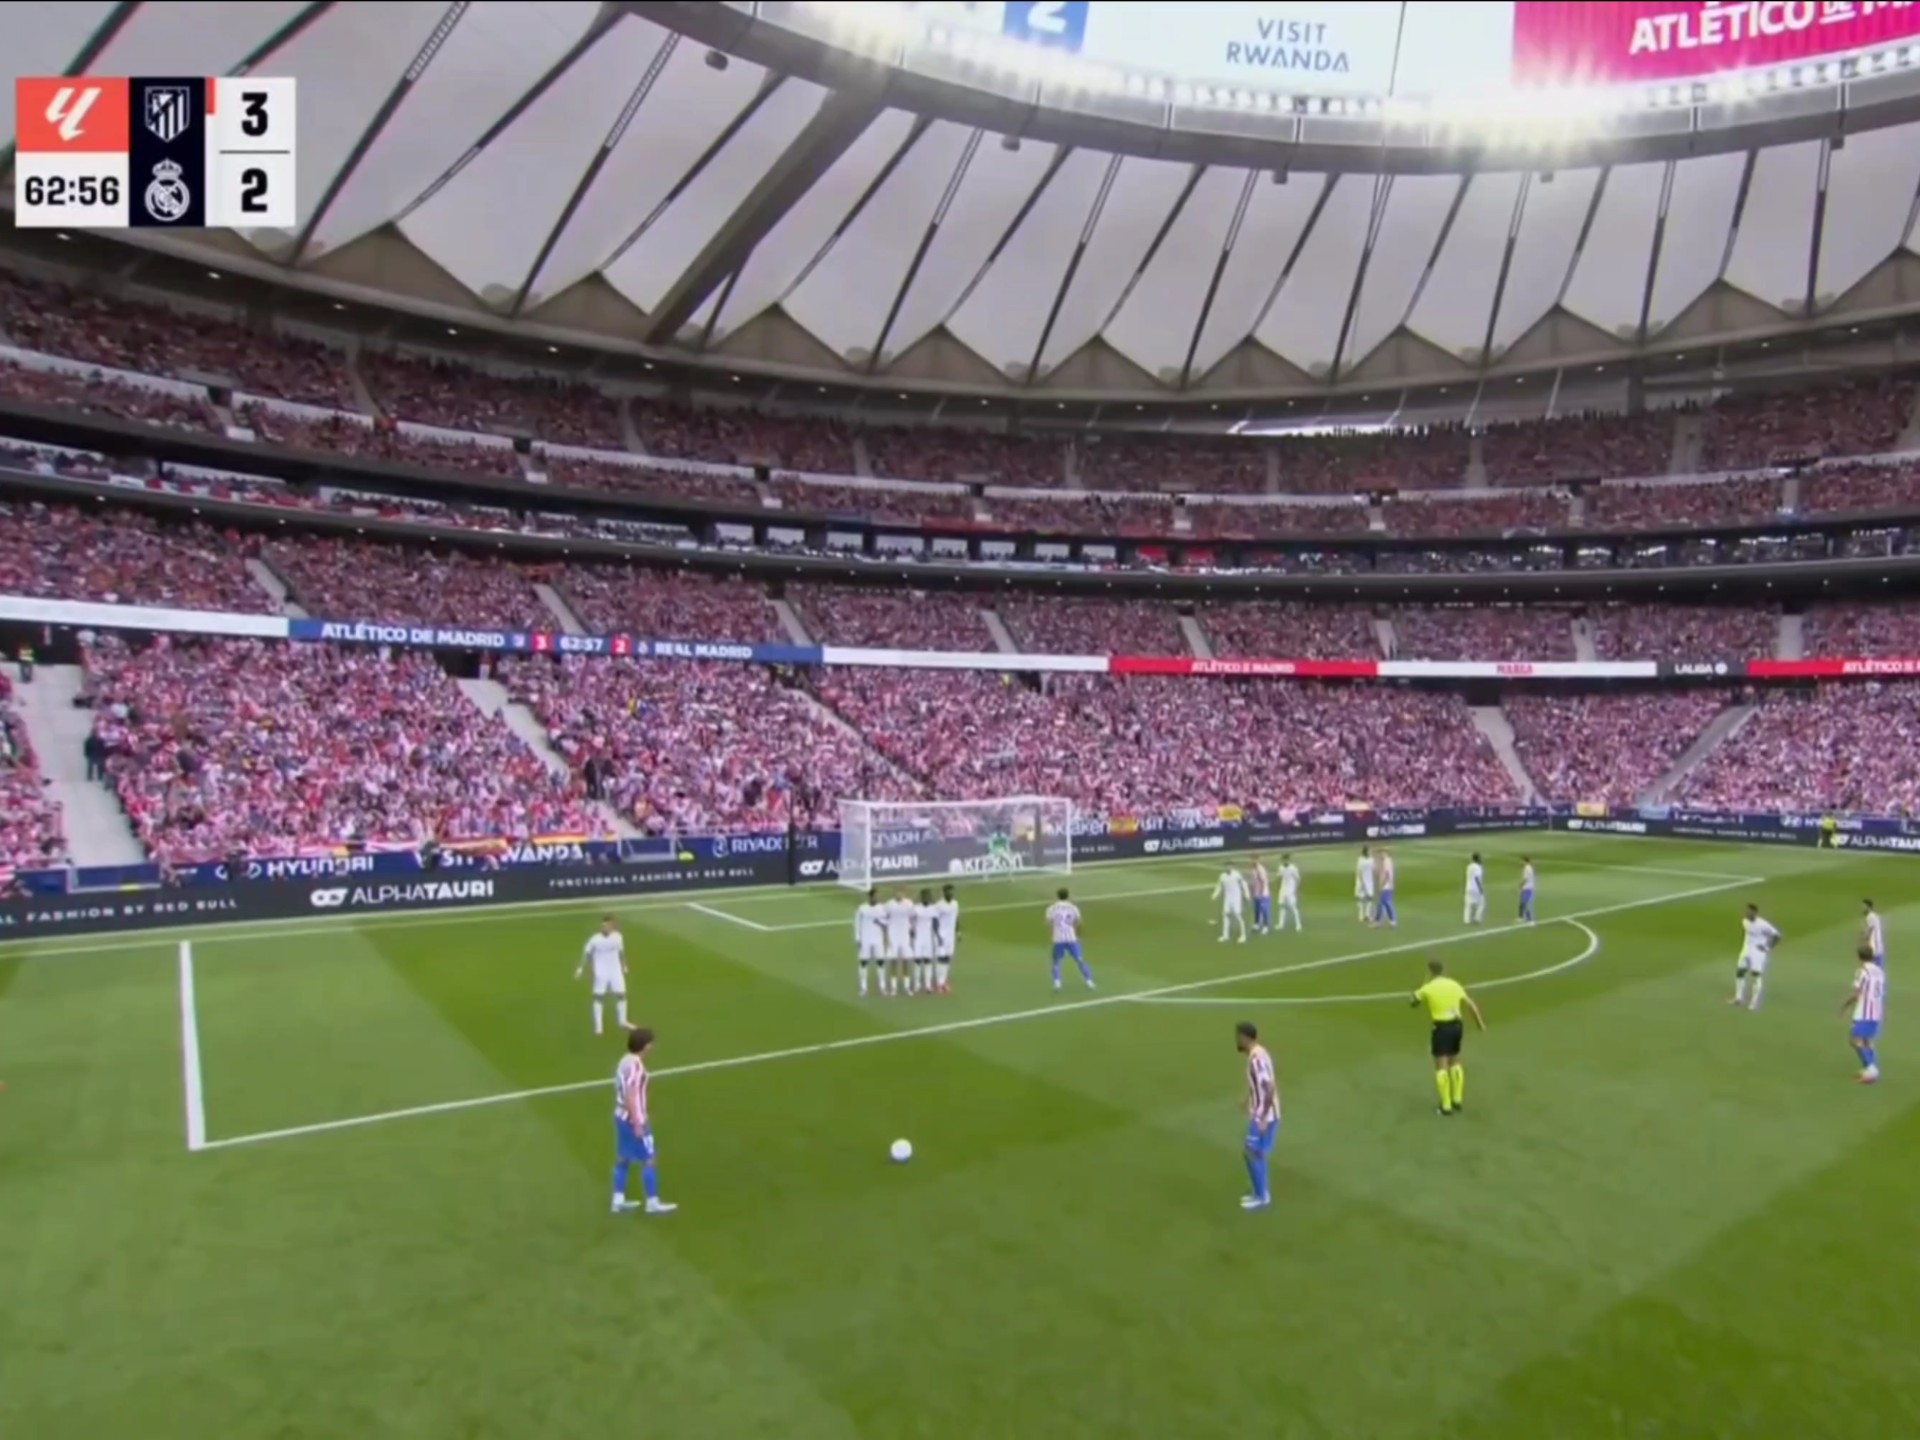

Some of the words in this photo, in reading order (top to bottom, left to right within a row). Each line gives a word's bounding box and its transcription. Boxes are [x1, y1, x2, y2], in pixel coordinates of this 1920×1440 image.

[1257, 18, 1327, 43] VISIT
[1226, 42, 1350, 73] RWANDA
[321, 622, 407, 643] ATLÉTICO
[411, 629, 433, 644] DE
[437, 630, 505, 648] MADRID
[654, 641, 692, 656] REAL
[695, 643, 752, 659] MADRID
[351, 880, 494, 905] ALPHATAURI
[26, 907, 115, 922] FASHION
[124, 905, 146, 915] BY
[154, 902, 189, 913] RED
[197, 899, 237, 909] BULL
